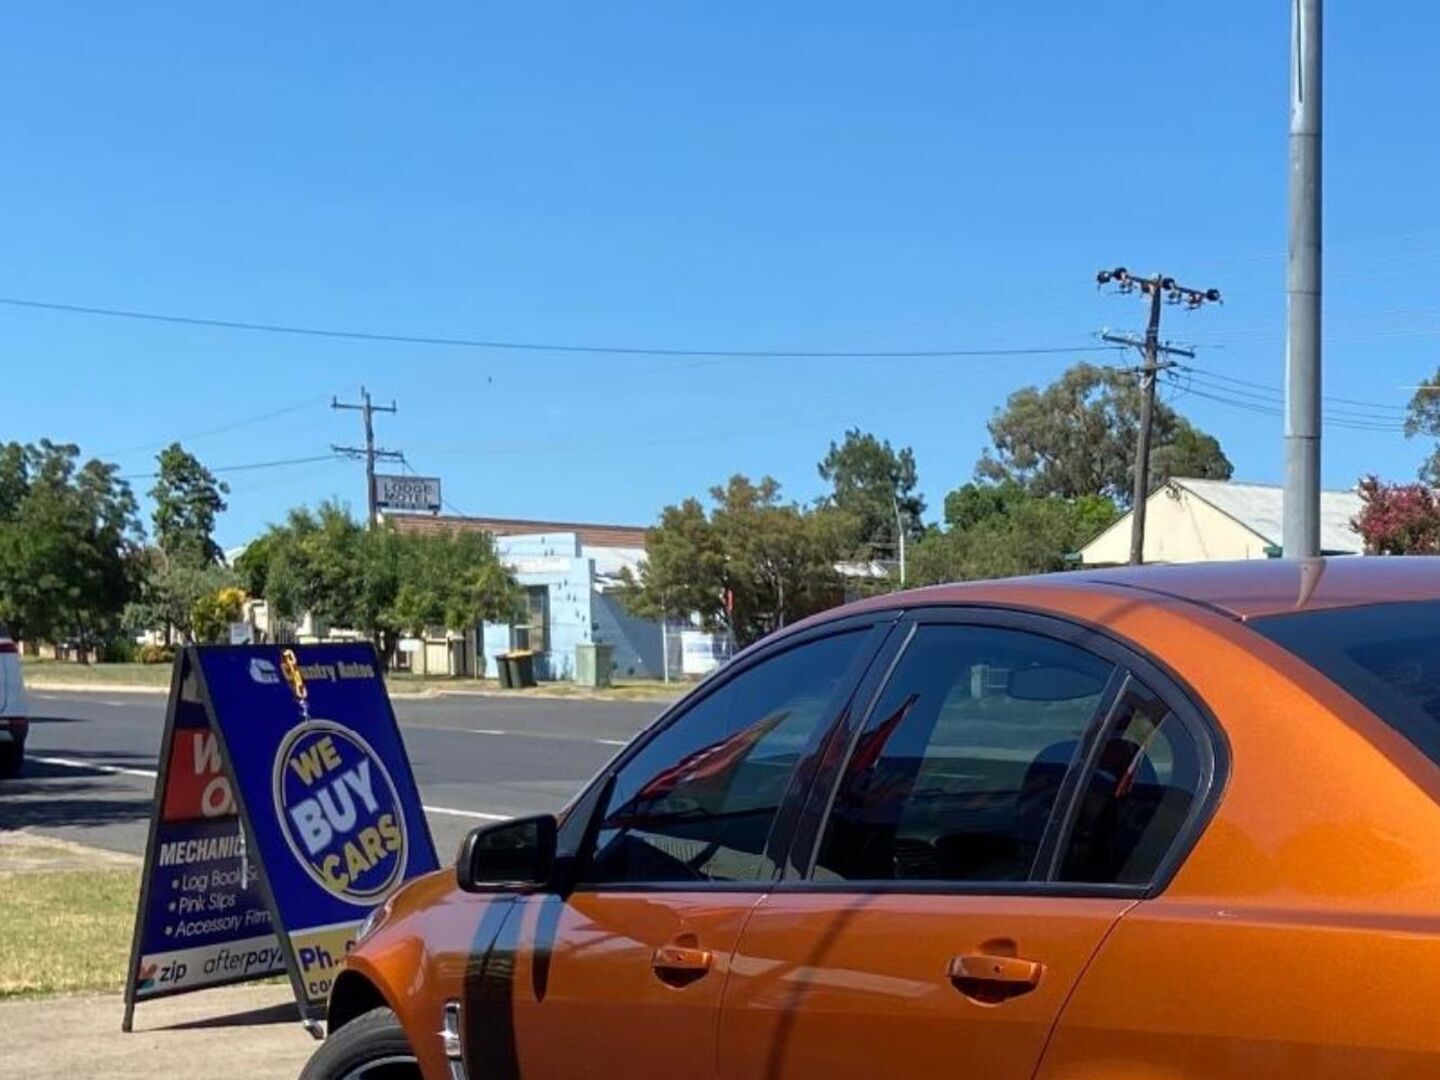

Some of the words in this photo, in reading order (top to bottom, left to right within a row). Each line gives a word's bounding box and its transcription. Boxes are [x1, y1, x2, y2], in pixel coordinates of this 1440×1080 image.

[385, 493, 431, 503] MOTEL
[282, 661, 338, 682] Cuntry
[290, 735, 342, 786] WE
[202, 776, 237, 816] O
[289, 757, 379, 856] BUY
[322, 814, 401, 892] CARS
[182, 873, 208, 892] Log
[178, 896, 205, 916] Pink
[208, 893, 236, 911] Slips
[174, 913, 243, 938] Accessory
[160, 960, 188, 984] zip
[203, 947, 280, 974] afterpay
[299, 945, 339, 972] Ph.
